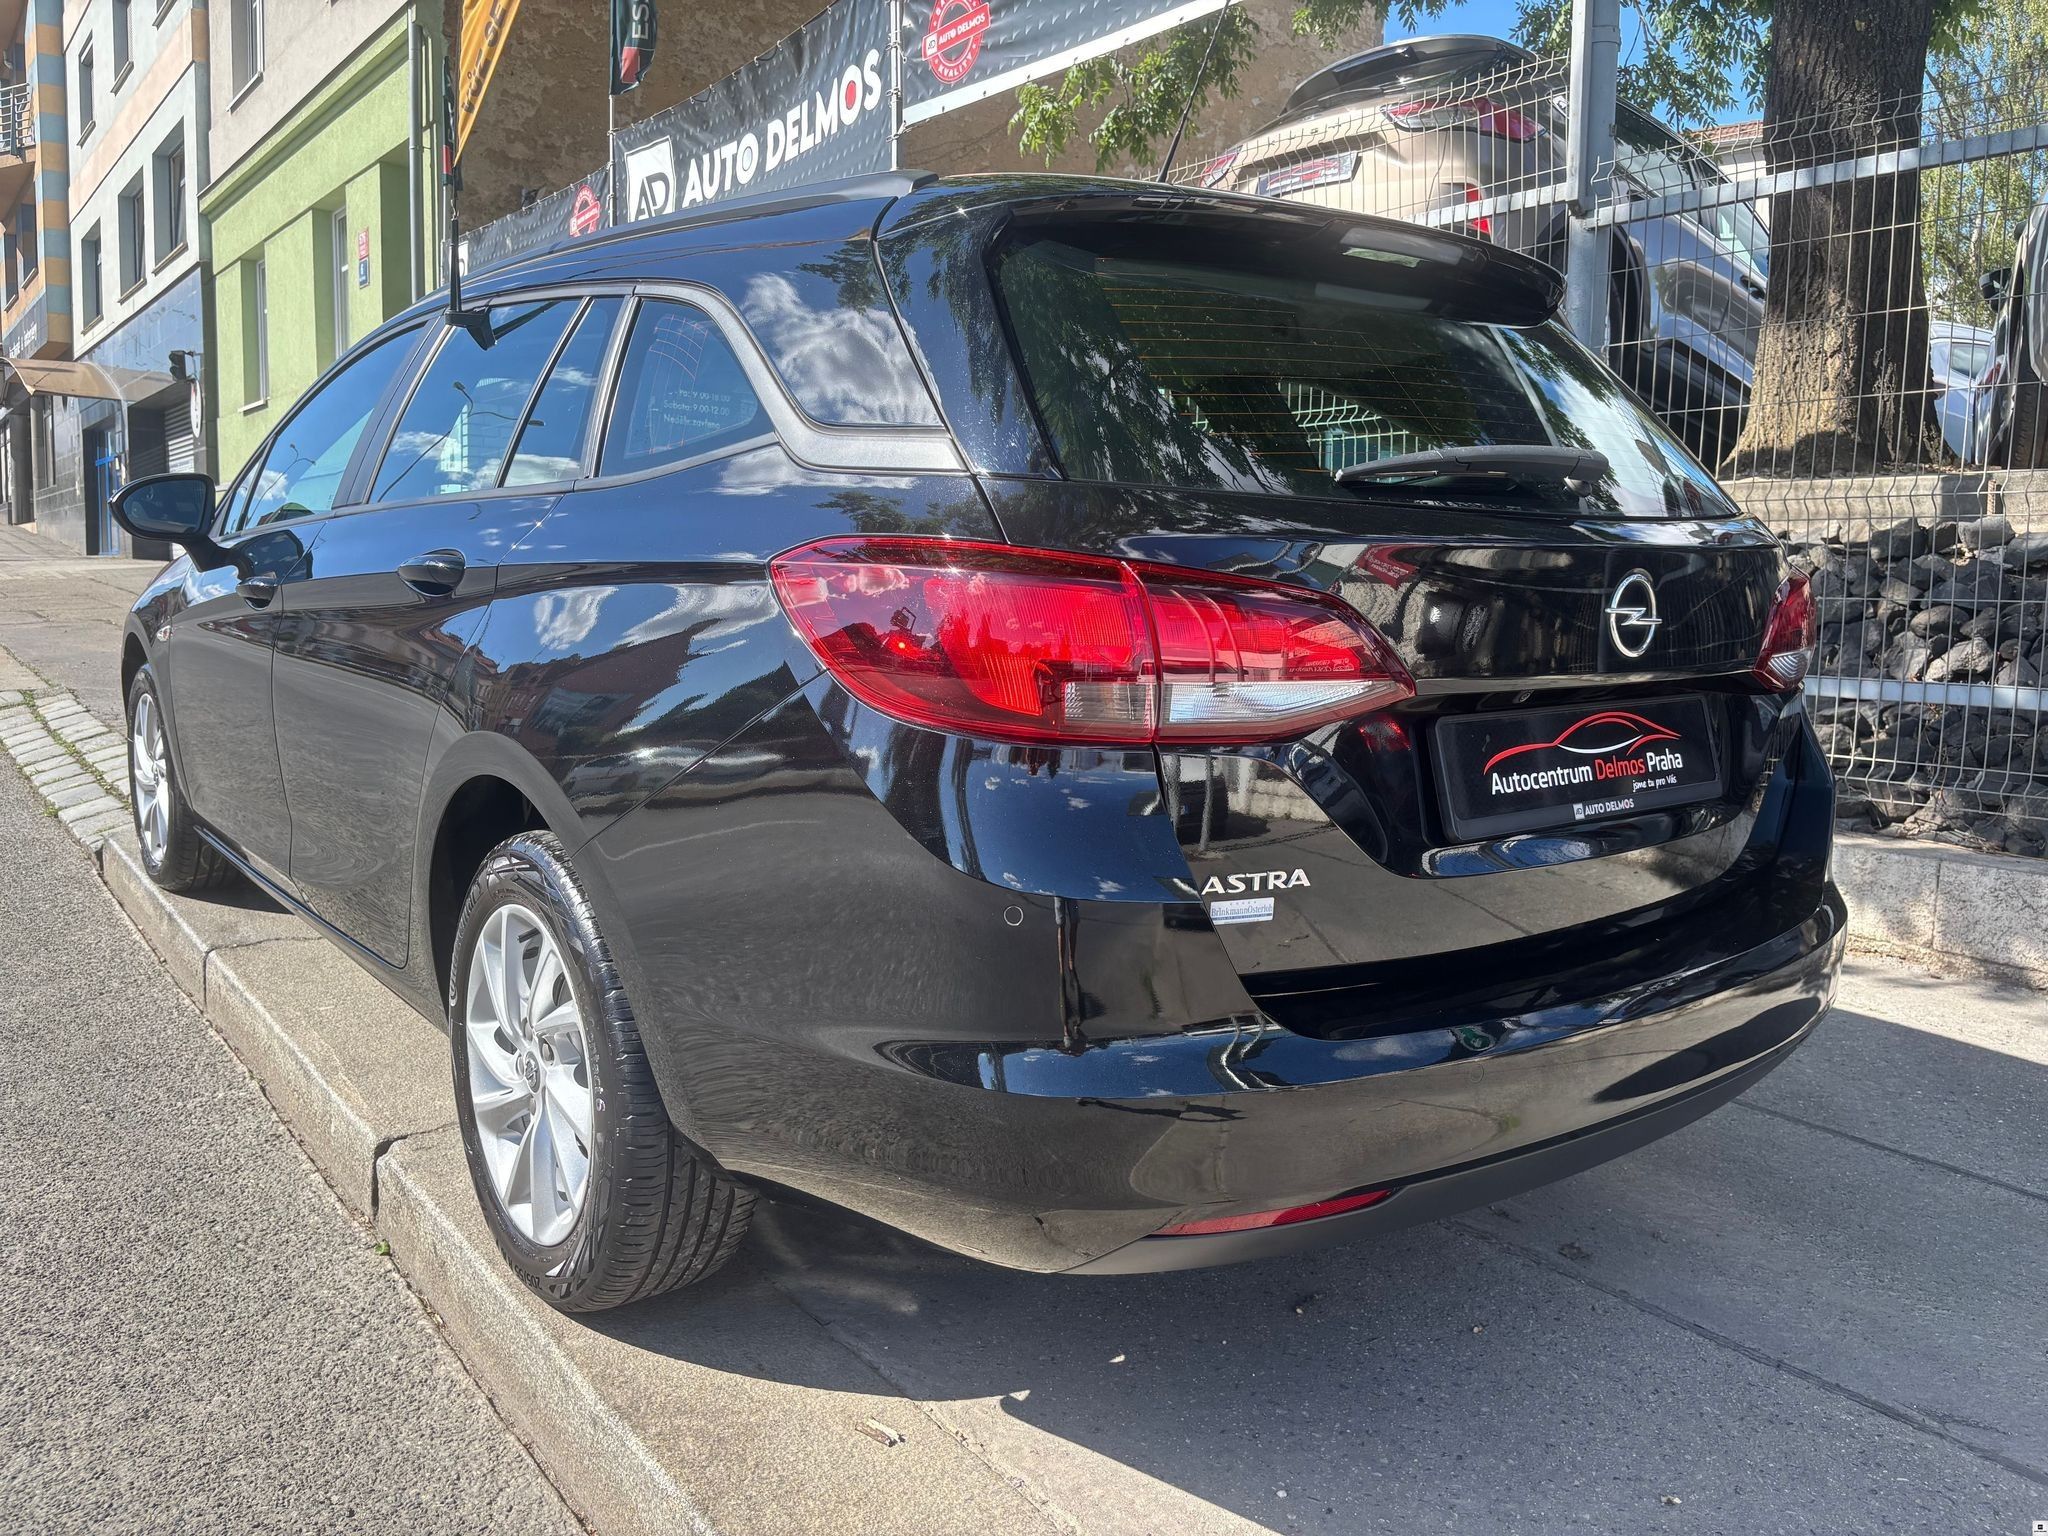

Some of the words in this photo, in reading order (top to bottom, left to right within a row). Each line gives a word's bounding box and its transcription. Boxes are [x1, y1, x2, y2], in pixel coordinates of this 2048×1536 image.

[631, 0, 650, 40] ES
[938, 28, 956, 45] AUTO
[957, 13, 986, 35] DELMOS
[938, 51, 972, 77] KVALITY
[681, 132, 759, 209] AUTO
[765, 48, 882, 172] DELMOS
[1491, 763, 1594, 796] Autocentrum
[1594, 755, 1646, 781] Delmos
[1646, 750, 1683, 774] Praha
[1632, 779, 1647, 793] jsme
[1647, 778, 1655, 787] tu
[1655, 778, 1666, 789] pro
[1666, 773, 1678, 784] Vás
[1585, 803, 1605, 816] AUTO
[1605, 798, 1634, 812] DELMOS
[1201, 868, 1311, 896] ASTRA
[595, 1097, 606, 1112] 6
